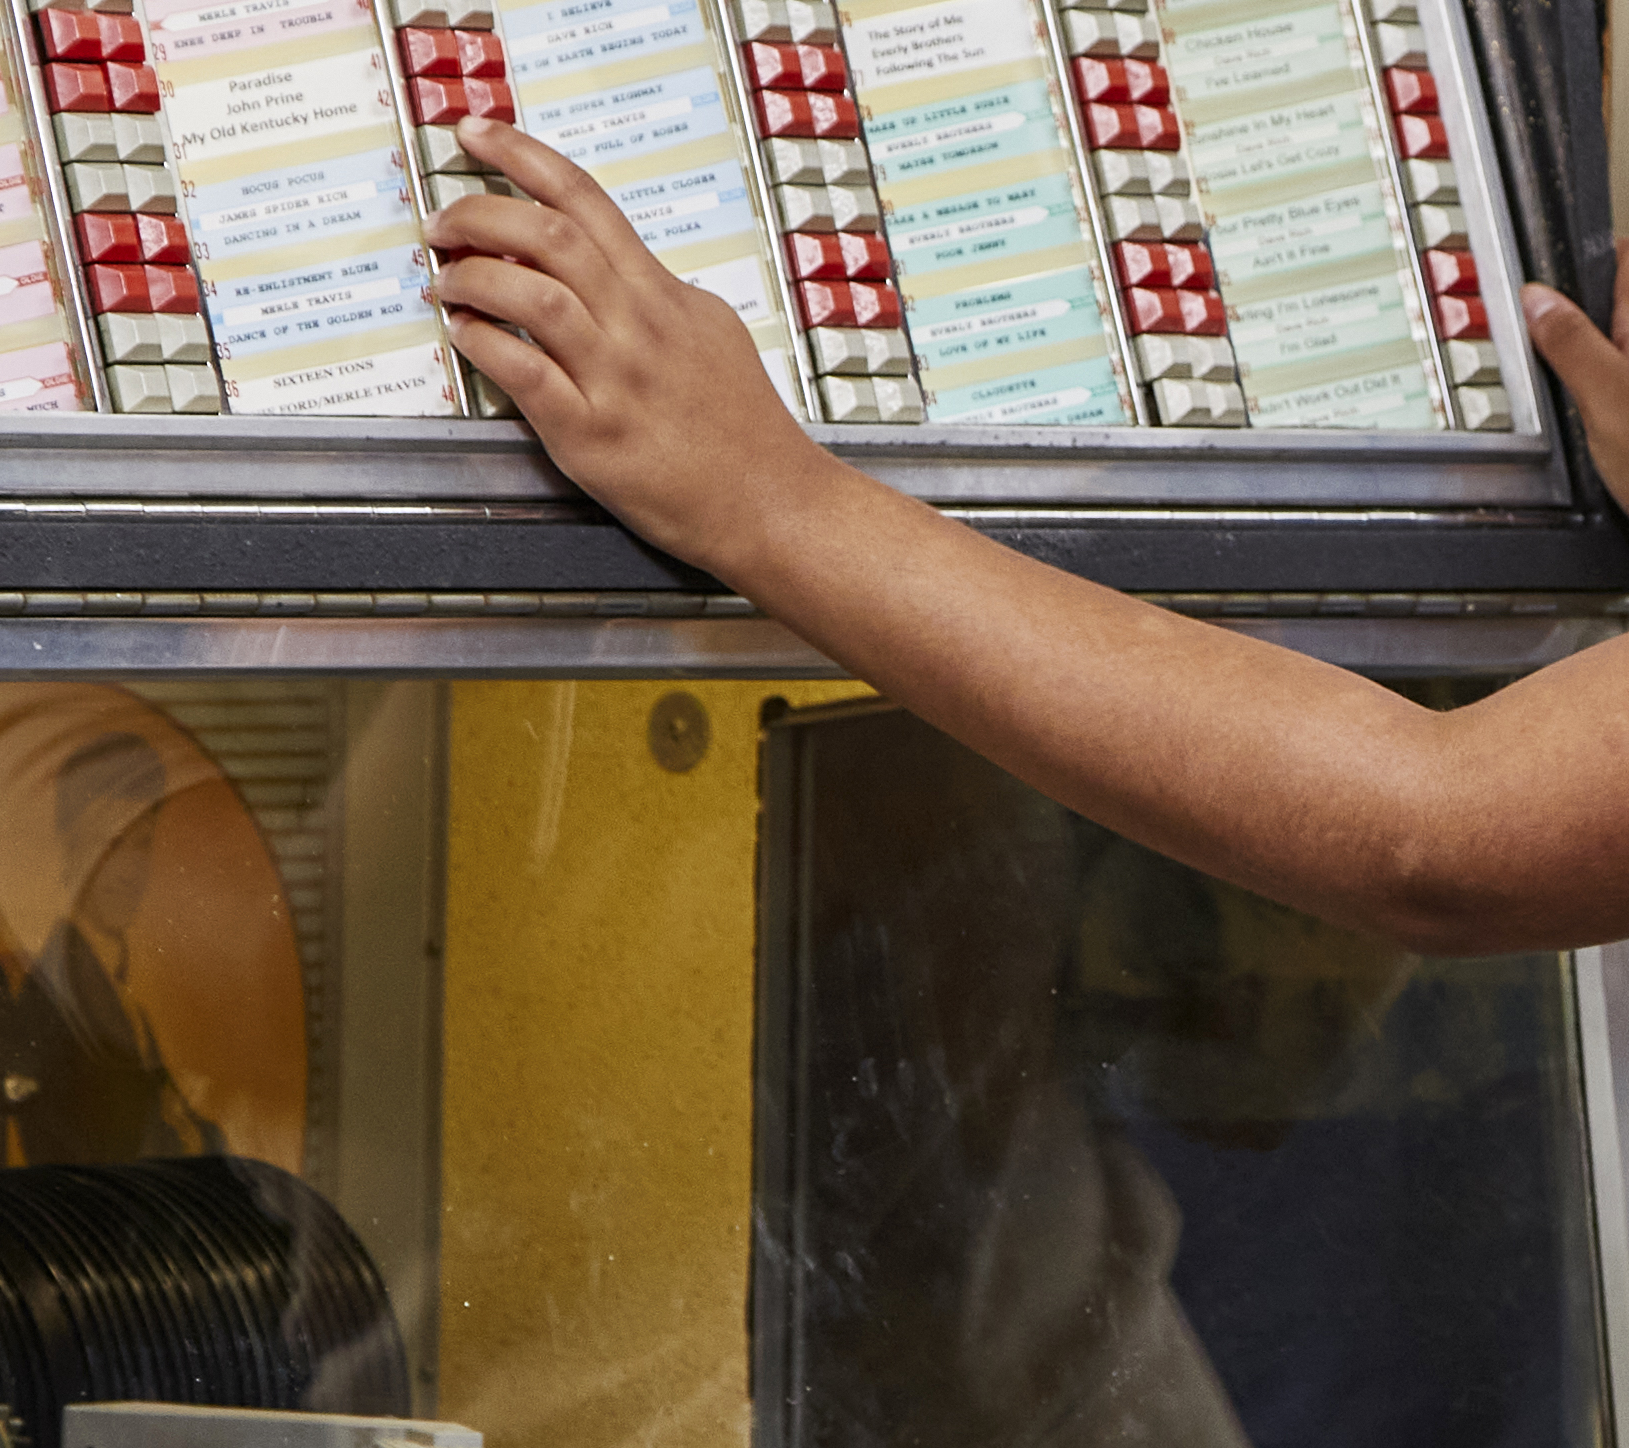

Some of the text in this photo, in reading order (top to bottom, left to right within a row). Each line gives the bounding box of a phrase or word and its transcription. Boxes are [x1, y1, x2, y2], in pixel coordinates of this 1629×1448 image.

[197, 6, 236, 22] MERLE
[173, 11, 333, 50] KNEE DEEP IN TROUBLE
[872, 33, 963, 59] Everly Brothers
[161, 81, 174, 98] 30
[229, 70, 292, 92] Paradise
[226, 91, 303, 115] John Prine
[182, 102, 357, 147] My Old Kentucky Home
[181, 181, 195, 198] 32
[241, 171, 325, 196] HOCUS POCUS
[620, 173, 717, 201] LITTLE CLOSER
[264, 197, 310, 216] SPIDER
[223, 226, 277, 246] DANCING
[284, 222, 300, 234] IN
[322, 210, 361, 227] DREAM
[664, 221, 702, 237] POLKA
[194, 242, 210, 259] 33
[202, 280, 217, 296] 34
[234, 261, 379, 298] RE-ENLISTMENT BLUES
[260, 290, 352, 316] MERLE TRAVIS
[227, 329, 266, 345] DANCE
[295, 319, 320, 332] THE
[326, 309, 373, 327] GOLDEN
[379, 303, 403, 317] ROD
[273, 361, 373, 389] SIXTEEN TONS
[373, 378, 425, 396] TRAVIS
